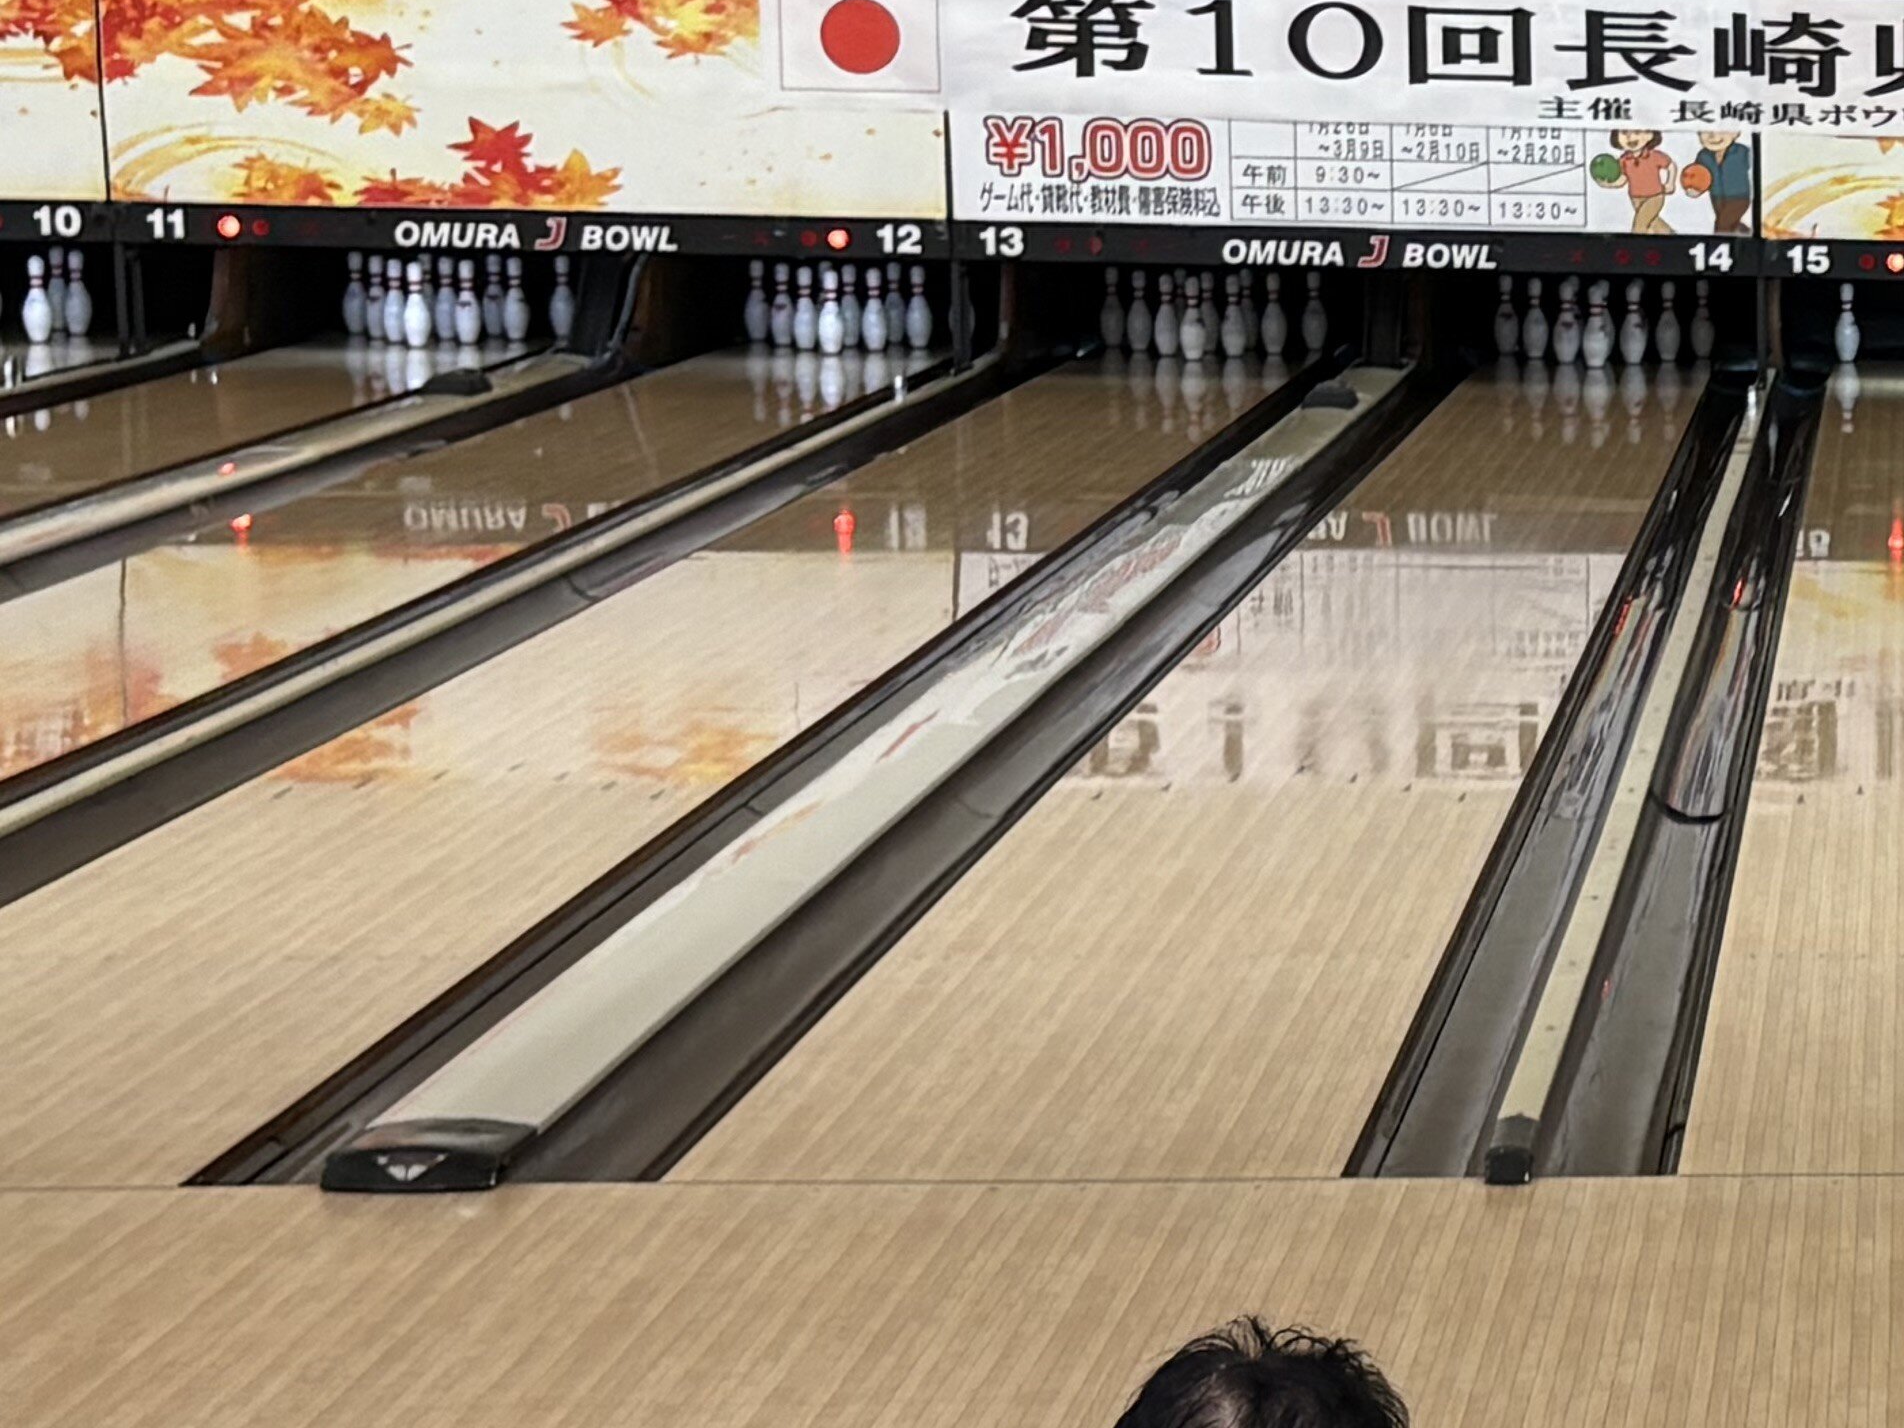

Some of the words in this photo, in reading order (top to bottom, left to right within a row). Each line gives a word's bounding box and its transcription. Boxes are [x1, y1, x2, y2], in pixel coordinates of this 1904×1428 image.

[1538, 97, 1633, 122] 主催
[982, 116, 1213, 183] ¥1,000
[1243, 163, 1287, 186] 午前
[1242, 193, 1286, 215] 午後
[33, 206, 82, 239] 10
[146, 207, 186, 241] 11
[394, 219, 521, 251] OMURA
[581, 224, 679, 254] BOWL
[876, 224, 923, 256] 12
[978, 229, 1025, 258] 13
[1222, 238, 1346, 268] OMURA
[1402, 241, 1498, 271] BOWL
[1688, 242, 1734, 273] 14
[1787, 245, 1831, 277] 15
